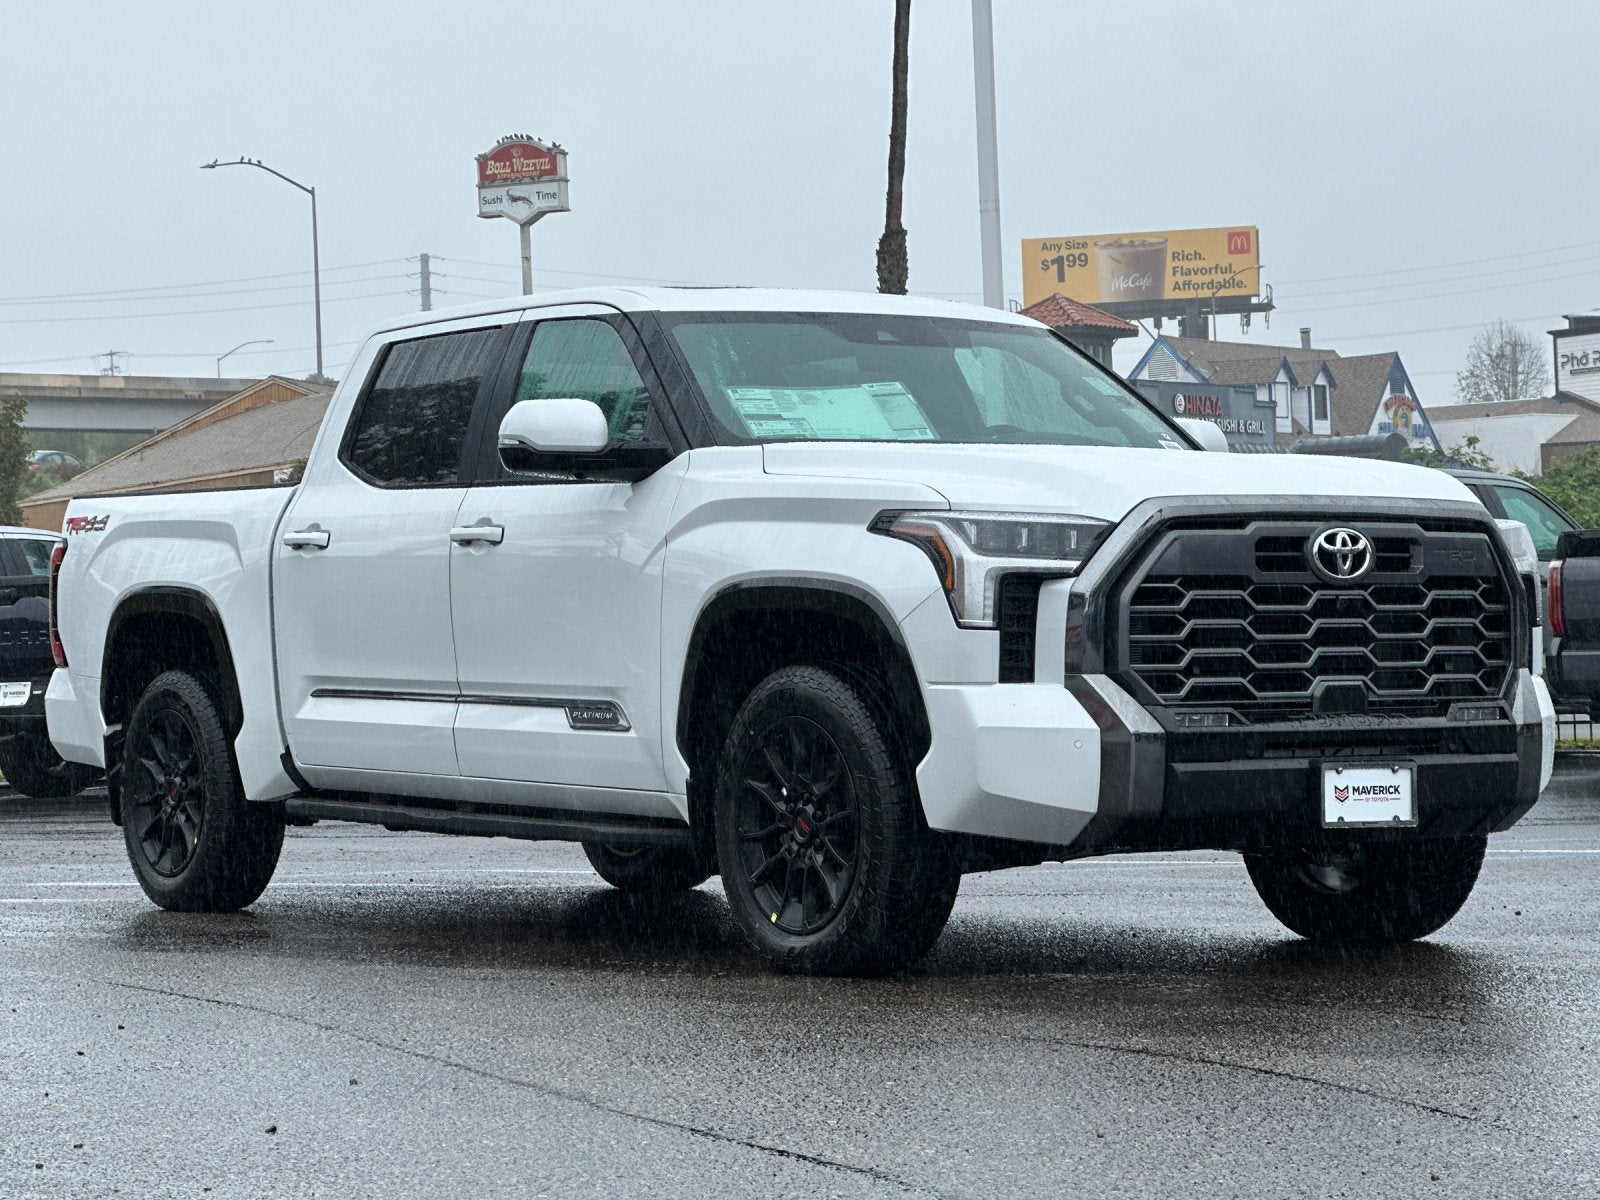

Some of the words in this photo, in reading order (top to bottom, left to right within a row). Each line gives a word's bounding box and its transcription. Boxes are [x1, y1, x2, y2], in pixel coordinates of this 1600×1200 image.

[486, 160, 511, 174] BOLL
[513, 158, 550, 172] WEEVIL
[482, 195, 503, 205] Sushi
[536, 191, 557, 200] Time
[1041, 242, 1062, 253] Any
[1065, 240, 1088, 250] Size
[1172, 250, 1205, 262] Rich.
[1172, 263, 1236, 277] Flavorful.
[1172, 278, 1247, 292] Affordable.
[1185, 394, 1222, 416] HINATA
[1217, 419, 1238, 433] SUSHI
[1239, 420, 1245, 433] &
[1246, 420, 1266, 434] GRILL
[572, 711, 613, 720] PLATINUM
[1352, 785, 1400, 796] MAVERICK
